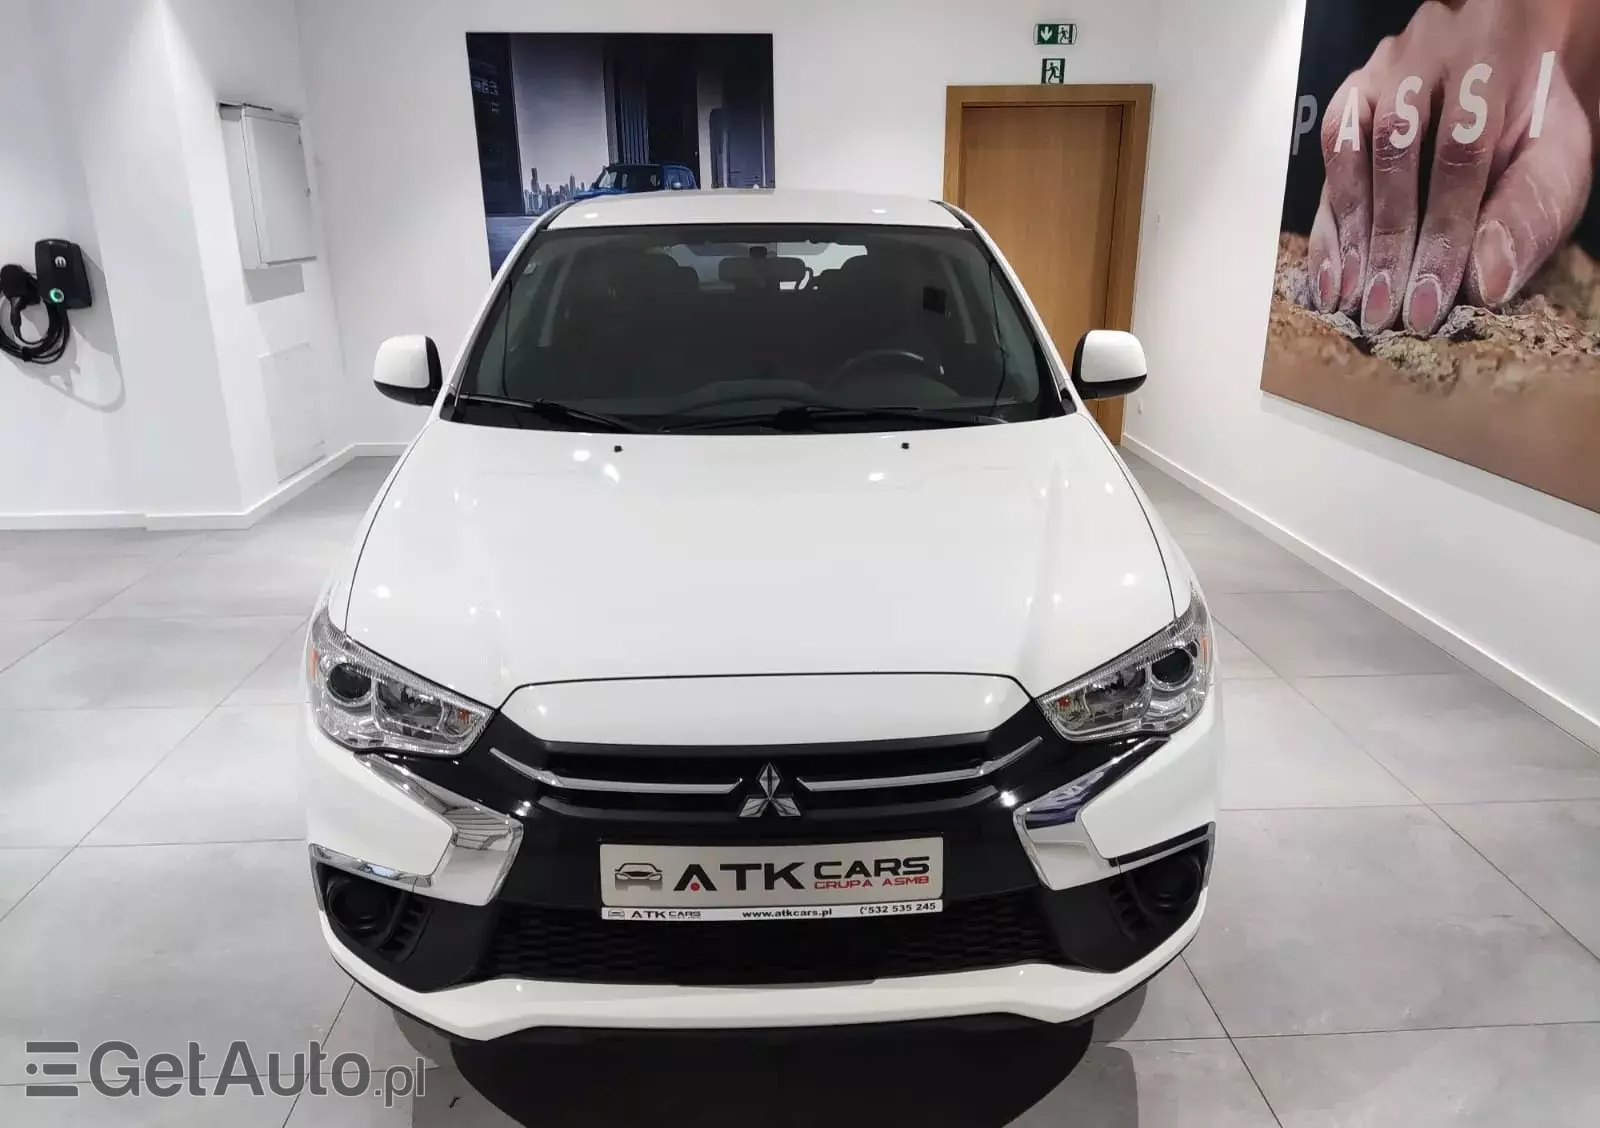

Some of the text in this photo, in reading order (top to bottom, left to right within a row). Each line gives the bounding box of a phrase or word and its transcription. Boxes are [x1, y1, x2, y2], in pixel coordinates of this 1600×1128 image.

[673, 856, 931, 892] ATK CARS
[813, 875, 930, 890] GRUPA ASMB
[741, 908, 833, 919] www.atkcars.pl
[868, 902, 936, 914] 532 535 245
[631, 910, 666, 919] ATK
